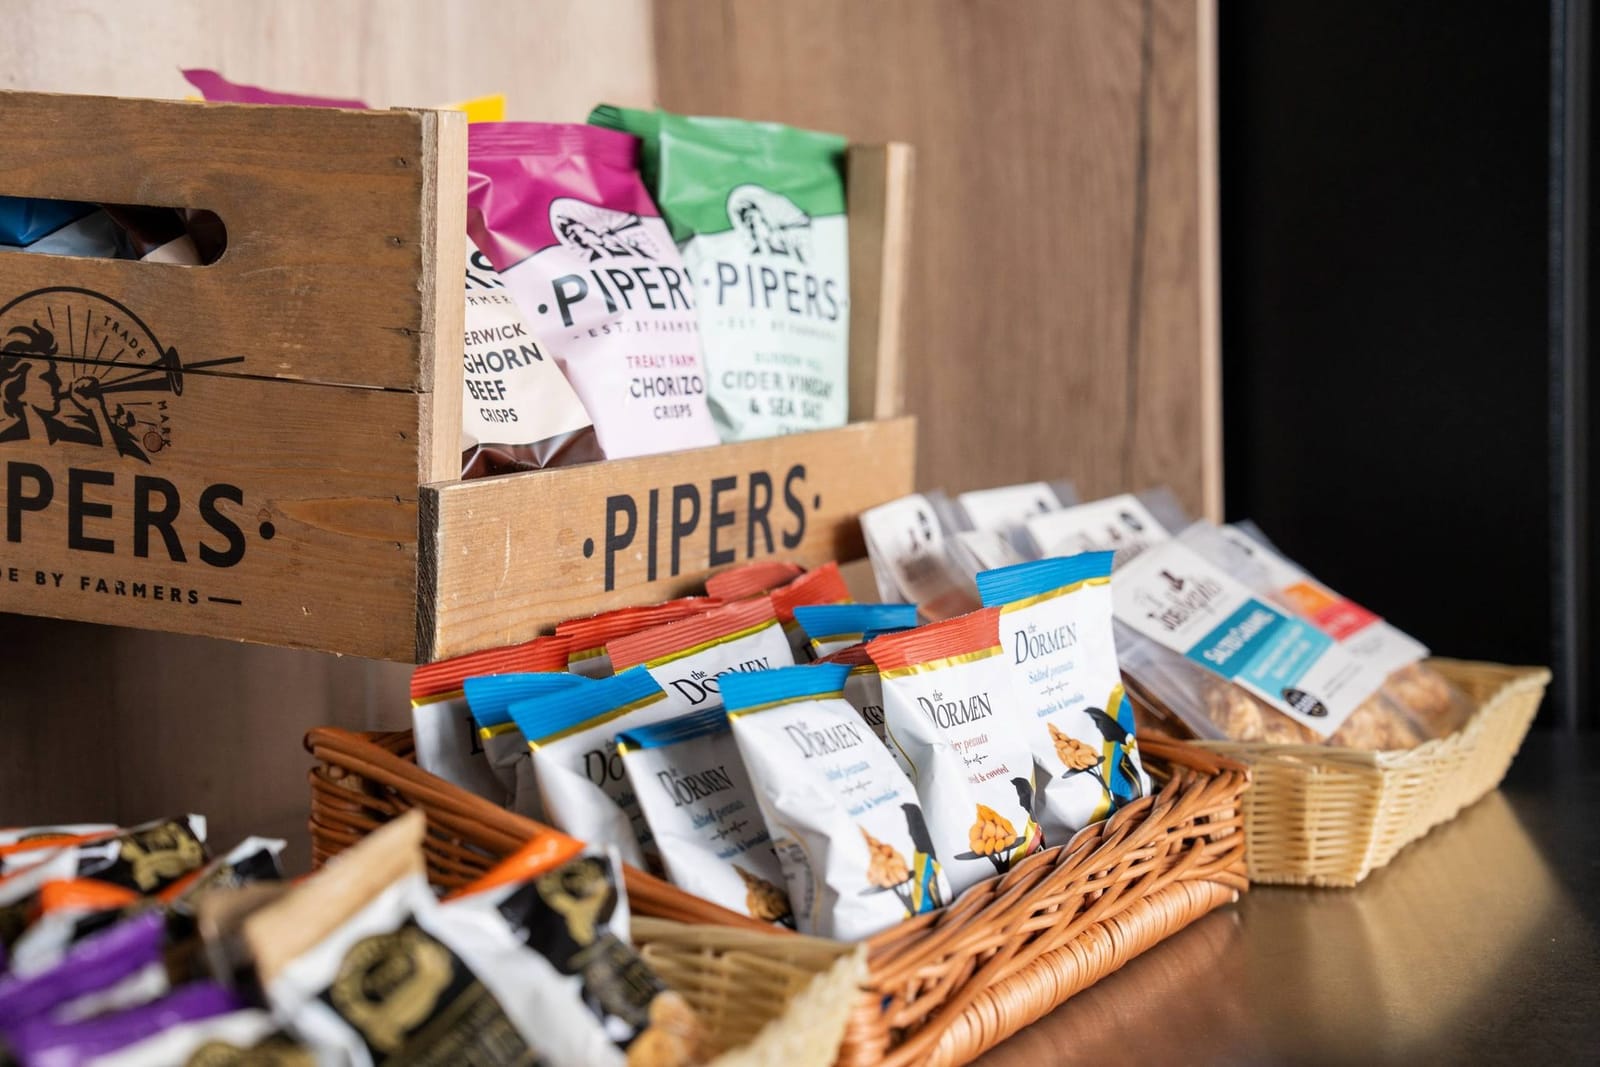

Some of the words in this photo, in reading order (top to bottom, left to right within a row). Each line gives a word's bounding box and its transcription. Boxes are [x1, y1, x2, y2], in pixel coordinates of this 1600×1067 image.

[552, 266, 694, 327] PIPER
[717, 262, 839, 321] PIPERS
[103, 315, 147, 359] TRADE
[465, 379, 507, 401] BEEF
[630, 376, 704, 398] CHORIZO
[157, 401, 172, 448] MARK
[480, 408, 519, 423] CRISPS
[654, 404, 692, 420] CRISPS
[604, 464, 807, 592] PIPERS
[36, 571, 64, 588] BY
[81, 576, 199, 605] FARMERS
[691, 670, 707, 681] the
